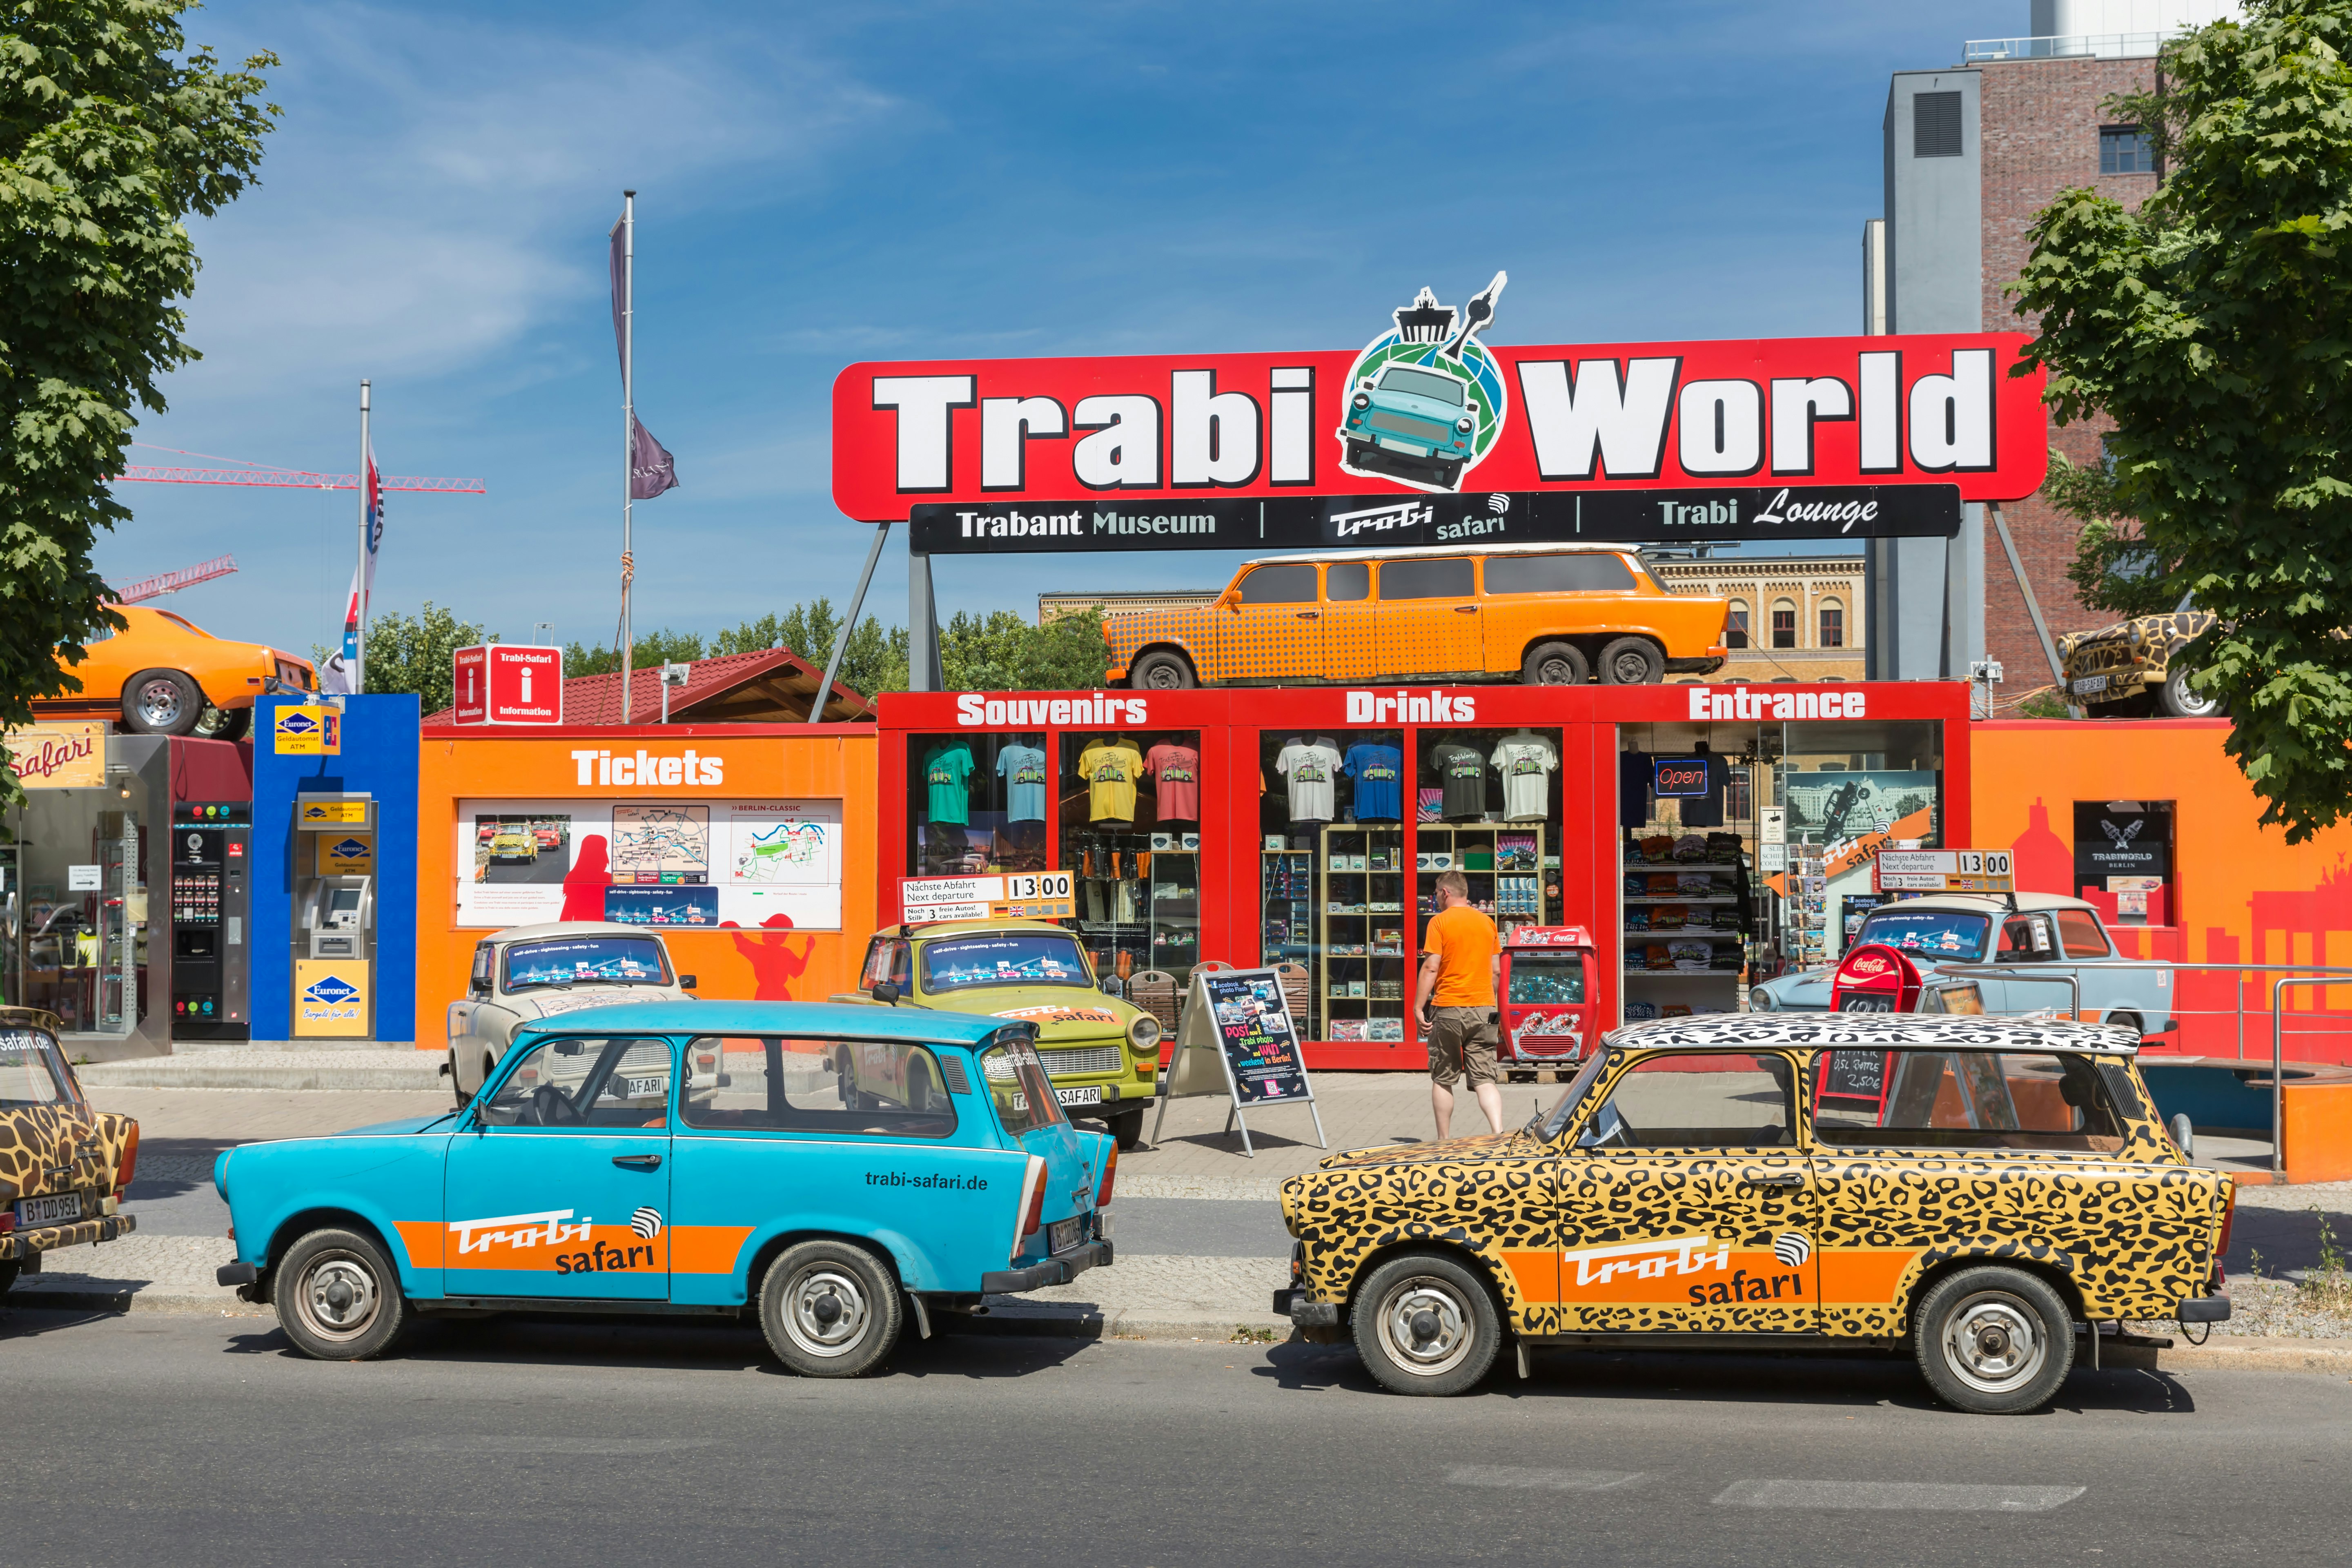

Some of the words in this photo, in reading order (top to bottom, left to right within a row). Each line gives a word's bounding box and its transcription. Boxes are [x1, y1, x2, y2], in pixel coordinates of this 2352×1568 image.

[872, 366, 1315, 494] Trabi
[1516, 348, 1996, 482] World
[956, 512, 1082, 537] Trabant
[1093, 510, 1215, 535] Museum
[1330, 502, 1434, 537] Trabi
[1437, 515, 1505, 541] safari
[1657, 499, 1738, 525] Trabi
[1753, 488, 1879, 534] Lounge
[459, 654, 482, 664] Trabi-Safari
[500, 653, 551, 663] Trabi-Safari
[2074, 676, 2105, 693] TRABI-SAFARI
[459, 707, 482, 717] Information
[500, 706, 551, 716] Information
[958, 693, 1147, 725] Souvenirs
[1347, 691, 1474, 723] Drinks
[1689, 687, 1865, 719] Entrance
[9, 727, 92, 778] Safari
[572, 750, 723, 785] Tickets
[1660, 768, 1703, 790] Open
[1882, 853, 1909, 862] Nächste
[1964, 855, 2008, 873] 13:00
[1901, 863, 1934, 872] departure
[907, 882, 941, 891] Nächste
[944, 881, 976, 889] Abfahrt
[1013, 877, 1069, 897] 13:00
[932, 891, 974, 901] departure
[930, 909, 935, 919] 3
[314, 985, 350, 996] Euronet
[303, 1009, 328, 1020] Bargeld
[331, 1009, 341, 1021] für
[343, 1009, 360, 1018] alle!
[1053, 1011, 1115, 1022] safari
[1240, 1037, 1255, 1046] Trabi
[1257, 1036, 1274, 1044] photo
[1258, 1042, 1280, 1056] win
[1240, 1057, 1264, 1067] weekend
[1272, 1053, 1292, 1064] Berlin!
[865, 1171, 988, 1191] trabi-safari.de
[27, 1199, 35, 1222] B
[44, 1196, 58, 1218] DD
[59, 1194, 77, 1217] 951
[449, 1209, 592, 1254] Trabi
[555, 1241, 655, 1275] safari
[1056, 1227, 1062, 1247] B
[1565, 1236, 1730, 1286] Trabi
[1688, 1270, 1802, 1307] safari
